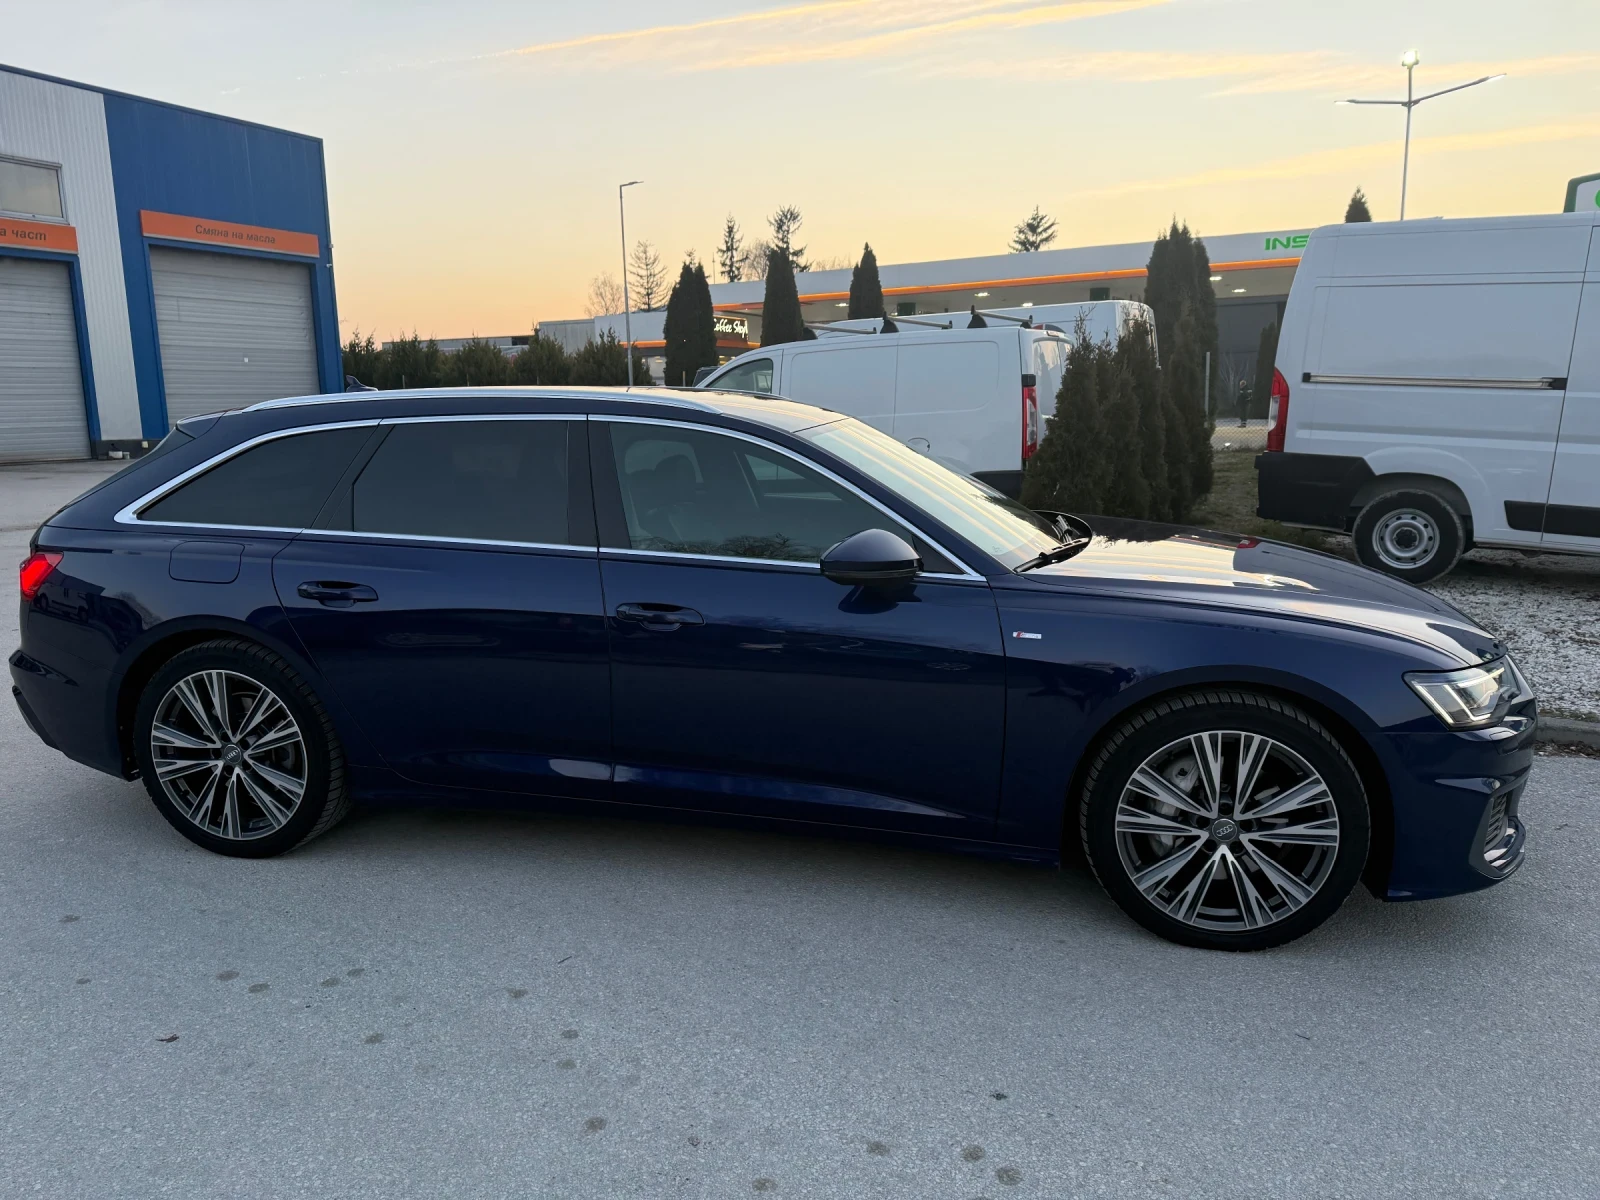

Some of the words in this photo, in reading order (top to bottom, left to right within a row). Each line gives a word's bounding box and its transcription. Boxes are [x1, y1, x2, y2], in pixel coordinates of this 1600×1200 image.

[11, 229, 47, 241] част
[195, 224, 229, 238] Смяна
[232, 231, 244, 240] на
[246, 233, 276, 244] масла
[1265, 234, 1310, 250] INS
[733, 320, 747, 338] Shop
